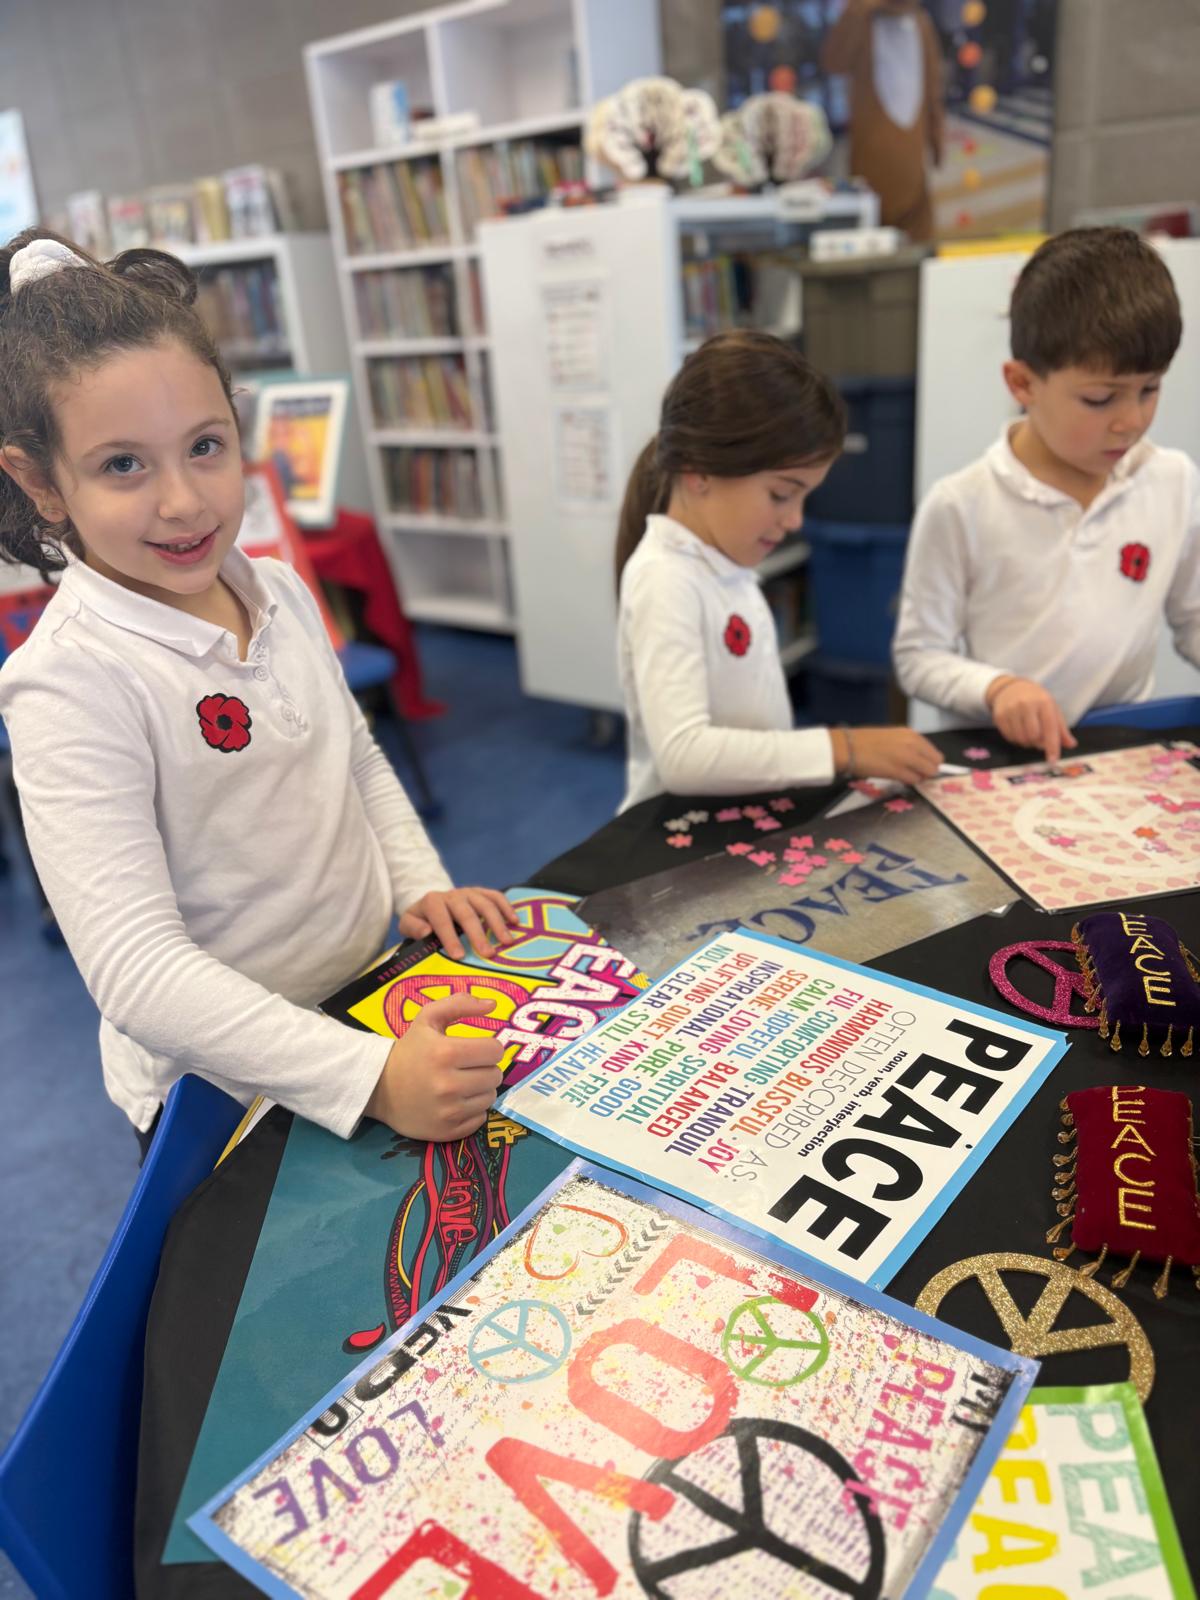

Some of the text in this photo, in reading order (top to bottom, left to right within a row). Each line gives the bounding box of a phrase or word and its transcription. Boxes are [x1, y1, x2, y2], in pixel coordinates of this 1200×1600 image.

[495, 943, 638, 1064] EACE
[528, 944, 734, 1096] NDLY CLEAR STILL HEAVEN
[560, 953, 758, 1108] UPLIFTING QUIET KIND FRIE
[589, 960, 783, 1117] INSPIRATIONAL PURE GOOD
[616, 970, 808, 1124] SERENE LOVING SPIRITUAL
[647, 979, 835, 1137] CALM HOPEFUL BALANCED
[664, 988, 864, 1156] FUL COMFORTING TRANQUIL
[697, 999, 893, 1174] HARMONIOUS BLISSFUL JOY
[724, 1011, 916, 1182] OFTEN DESCRIBED AS:
[767, 1018, 1034, 1261] PEACE
[797, 1051, 912, 1157] noun, verb, interjection
[252, 1399, 446, 1547] LOVE
[842, 1352, 956, 1532] PEACE
[1046, 1403, 1164, 1600] PEA
